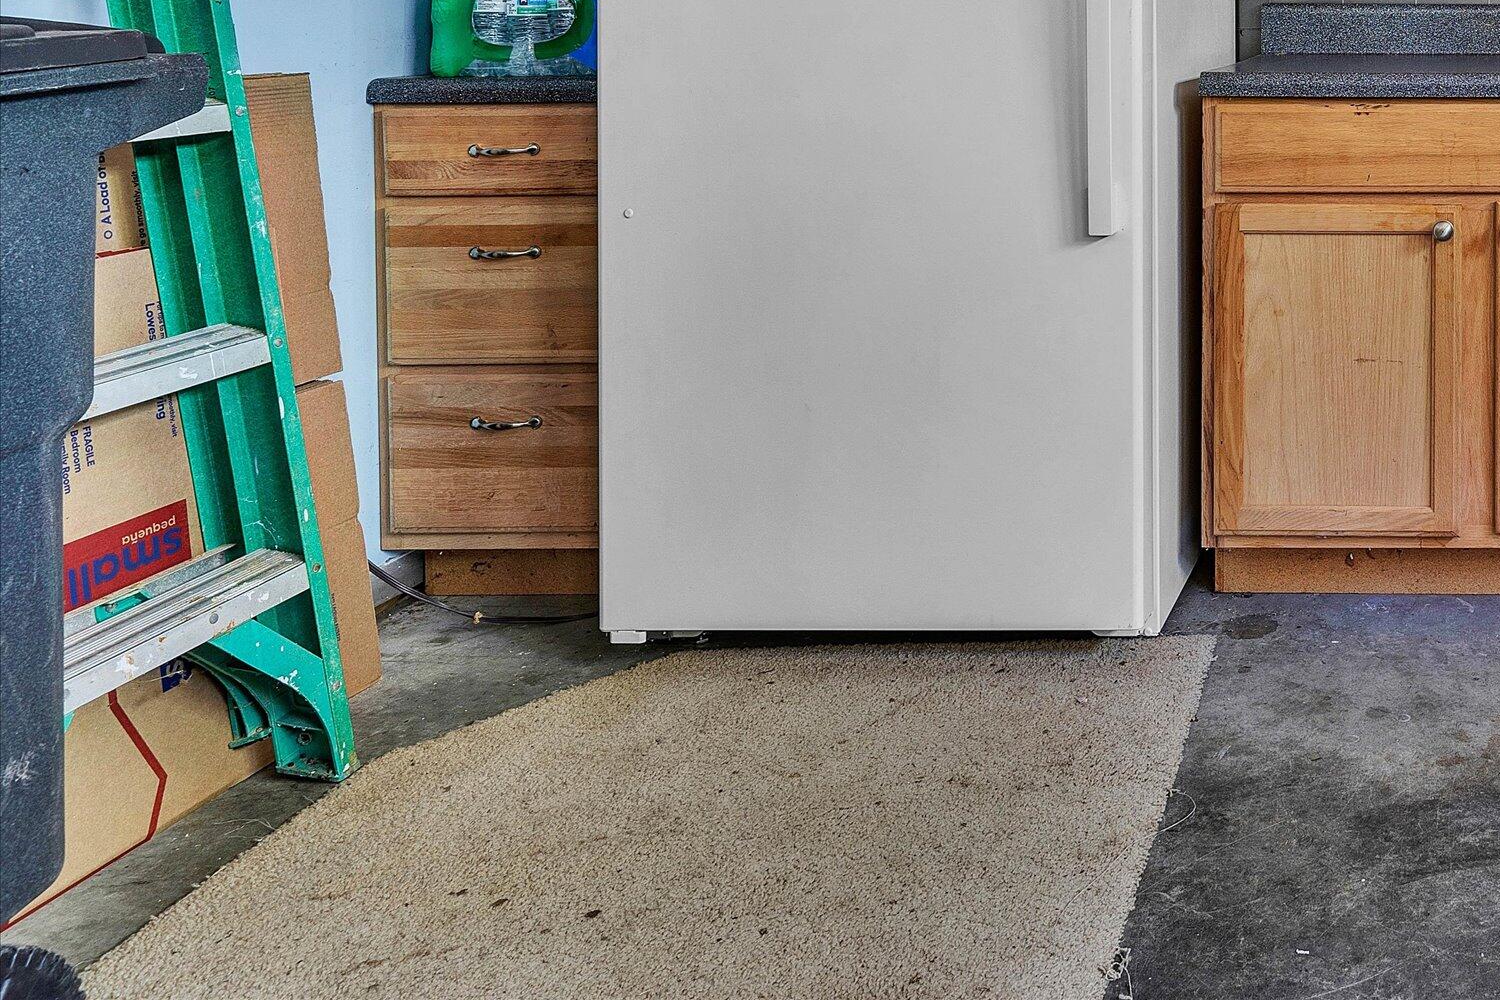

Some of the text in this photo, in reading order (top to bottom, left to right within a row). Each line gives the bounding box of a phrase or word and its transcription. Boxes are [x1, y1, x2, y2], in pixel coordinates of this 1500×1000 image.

[97, 181, 110, 214] Load
[132, 188, 144, 228] smoothly,
[100, 214, 112, 225] A
[137, 228, 146, 239] go
[82, 425, 96, 468] FRAGILE
[171, 423, 179, 438] visit
[70, 430, 82, 474] Bedroom
[61, 466, 72, 495] Room
[121, 514, 177, 545] pequeña
[67, 526, 183, 608] small
